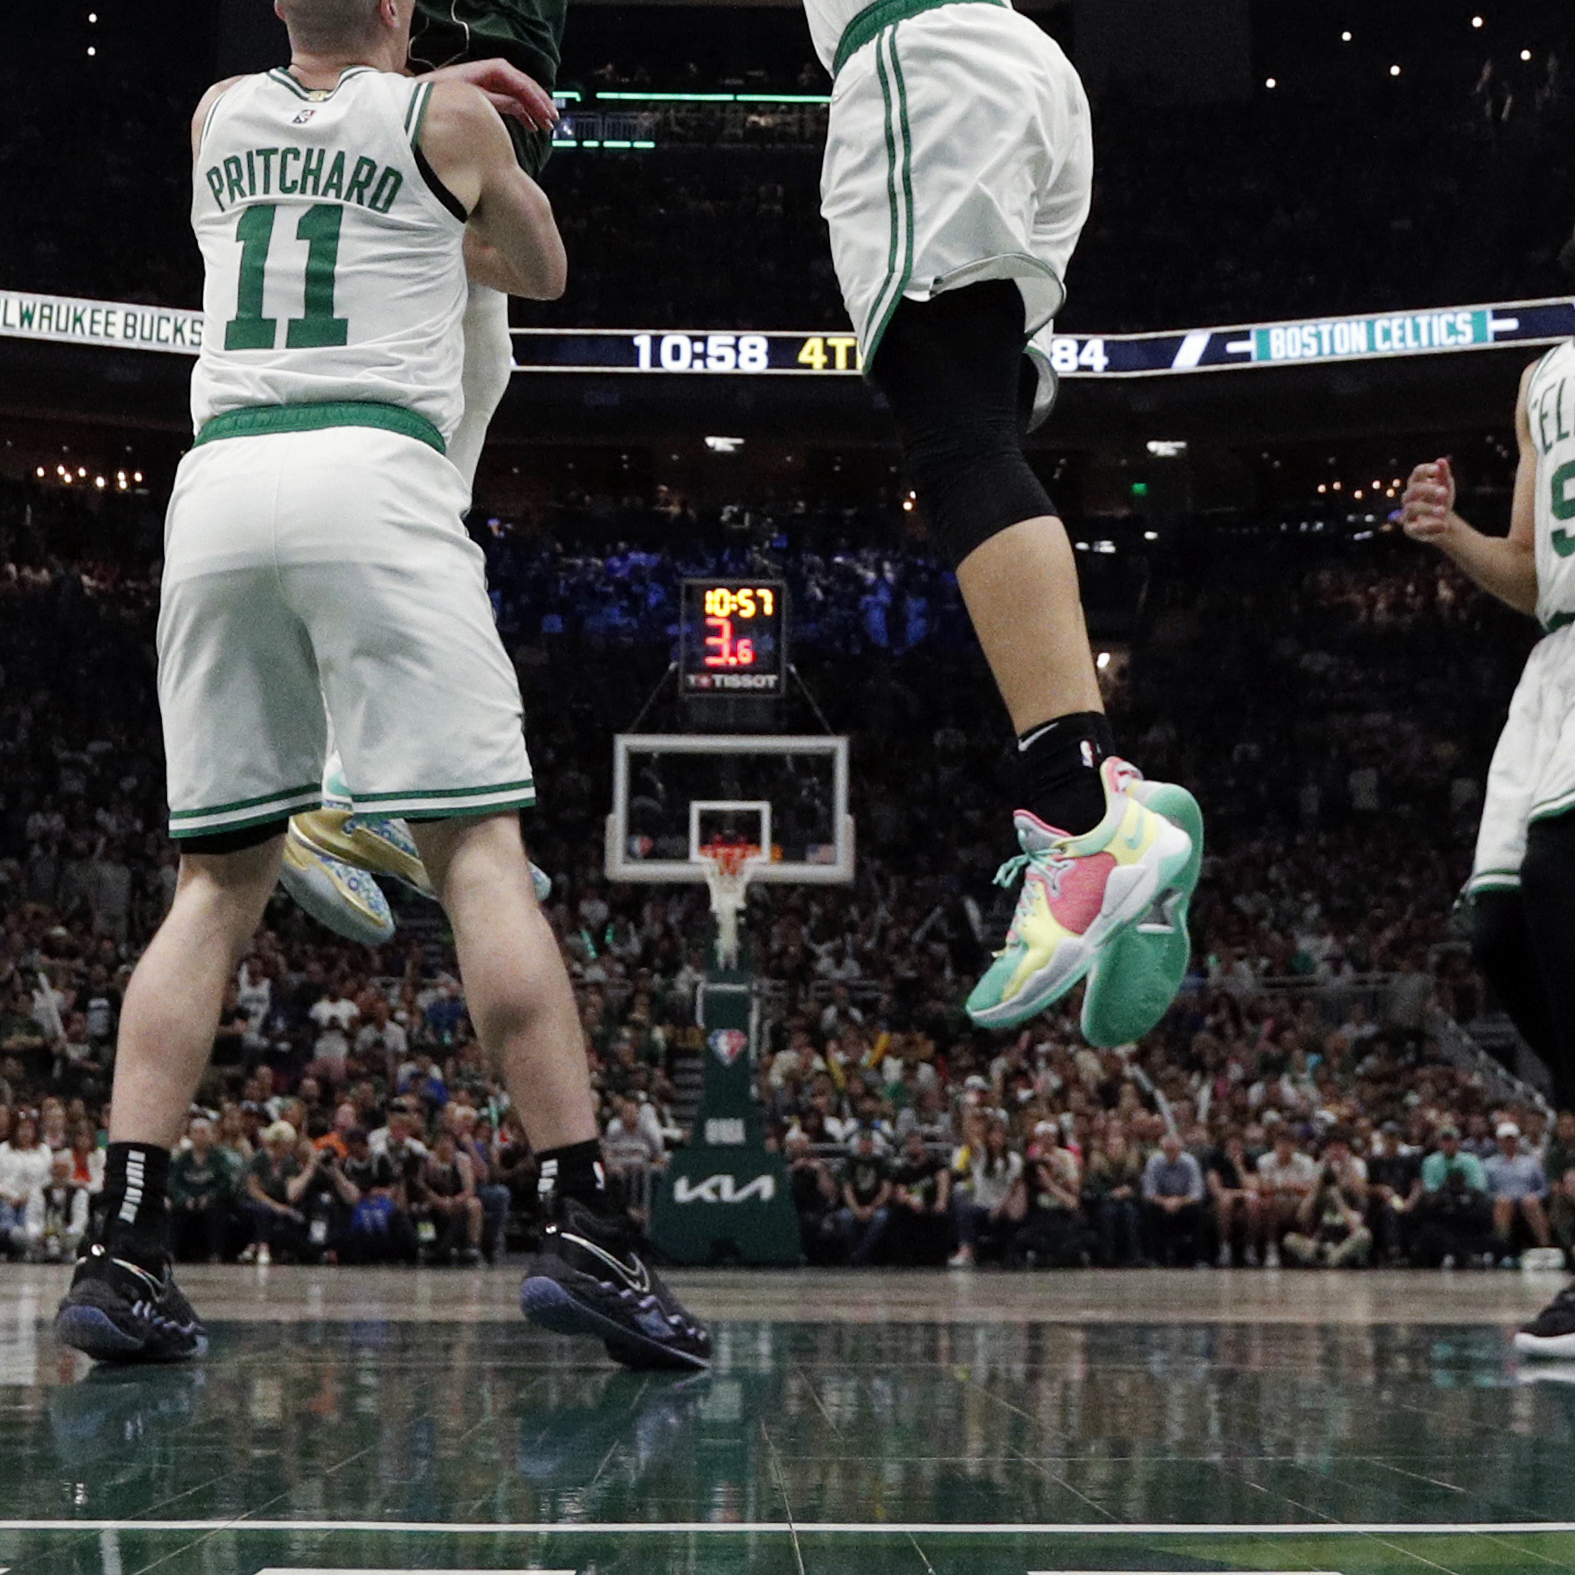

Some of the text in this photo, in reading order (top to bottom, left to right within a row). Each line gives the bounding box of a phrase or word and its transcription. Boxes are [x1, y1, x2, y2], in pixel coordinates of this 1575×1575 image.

[206, 147, 403, 214] PRITCHARD
[224, 204, 348, 350] 11
[124, 307, 202, 347] BUCKS
[1269, 312, 1472, 358] BOSTON CELTICS
[633, 335, 862, 372] 10:58 4T
[1050, 337, 1108, 372] 84
[705, 588, 773, 618] 10:57
[705, 617, 756, 666] 3.6
[712, 674, 777, 687] TISSOT
[674, 1174, 774, 1203] KIA
